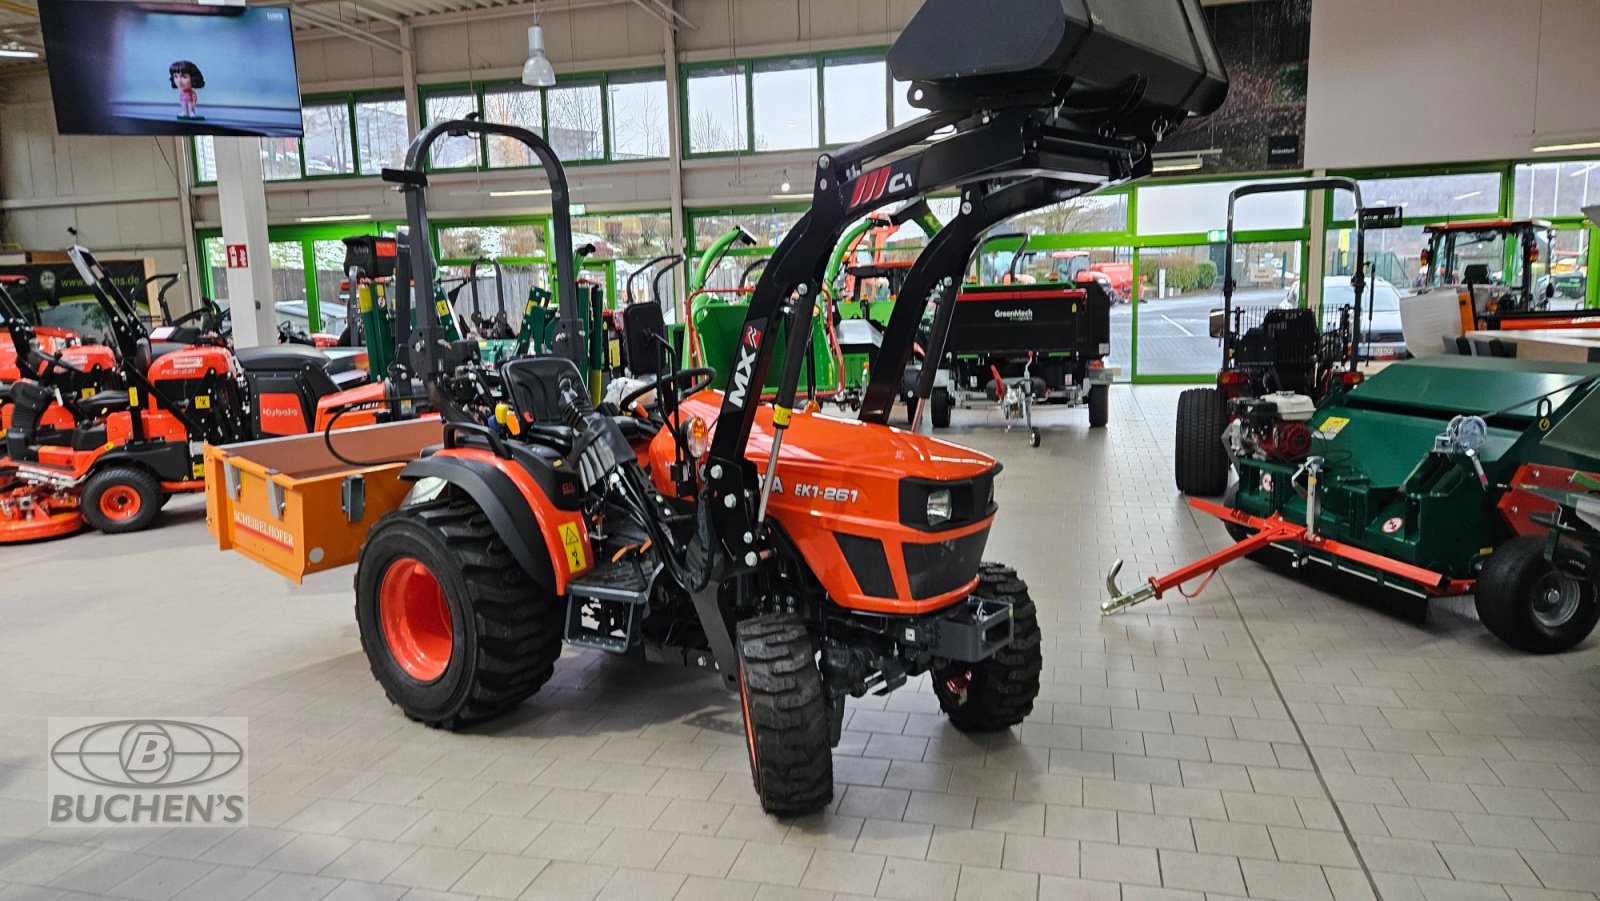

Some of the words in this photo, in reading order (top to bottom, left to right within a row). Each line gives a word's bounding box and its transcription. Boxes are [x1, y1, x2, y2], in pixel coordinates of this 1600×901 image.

[888, 172, 913, 194] C1
[994, 308, 1033, 318] GreenMech
[728, 343, 757, 409] MX
[262, 406, 298, 417] Kubota
[794, 483, 859, 504] EK1-261
[233, 510, 294, 546] SCHEIBELHOFER
